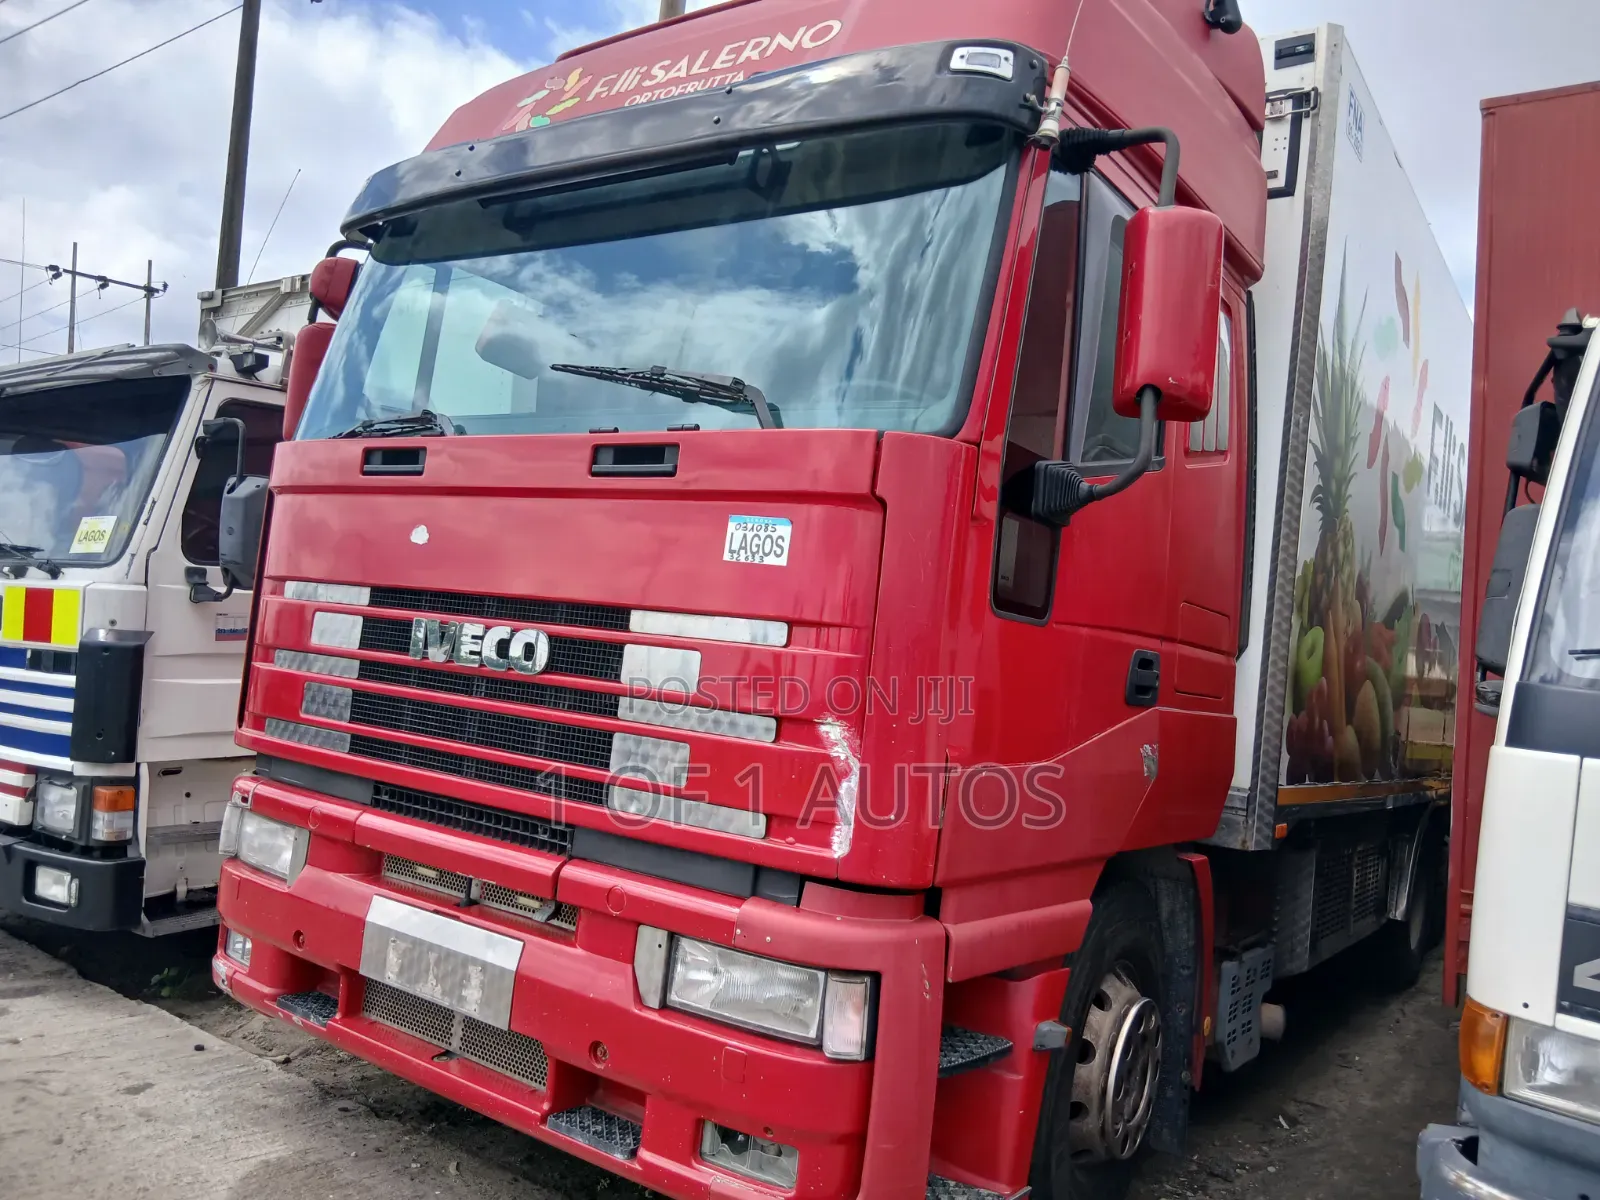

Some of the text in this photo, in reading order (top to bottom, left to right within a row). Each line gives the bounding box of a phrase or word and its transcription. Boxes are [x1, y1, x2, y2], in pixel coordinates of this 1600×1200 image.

[641, 20, 842, 88] SALERNO
[624, 69, 745, 107] ORTOFRUTTA
[78, 529, 106, 542] LAGOS
[728, 532, 785, 558] LAGOS
[409, 617, 549, 675] IVECO
